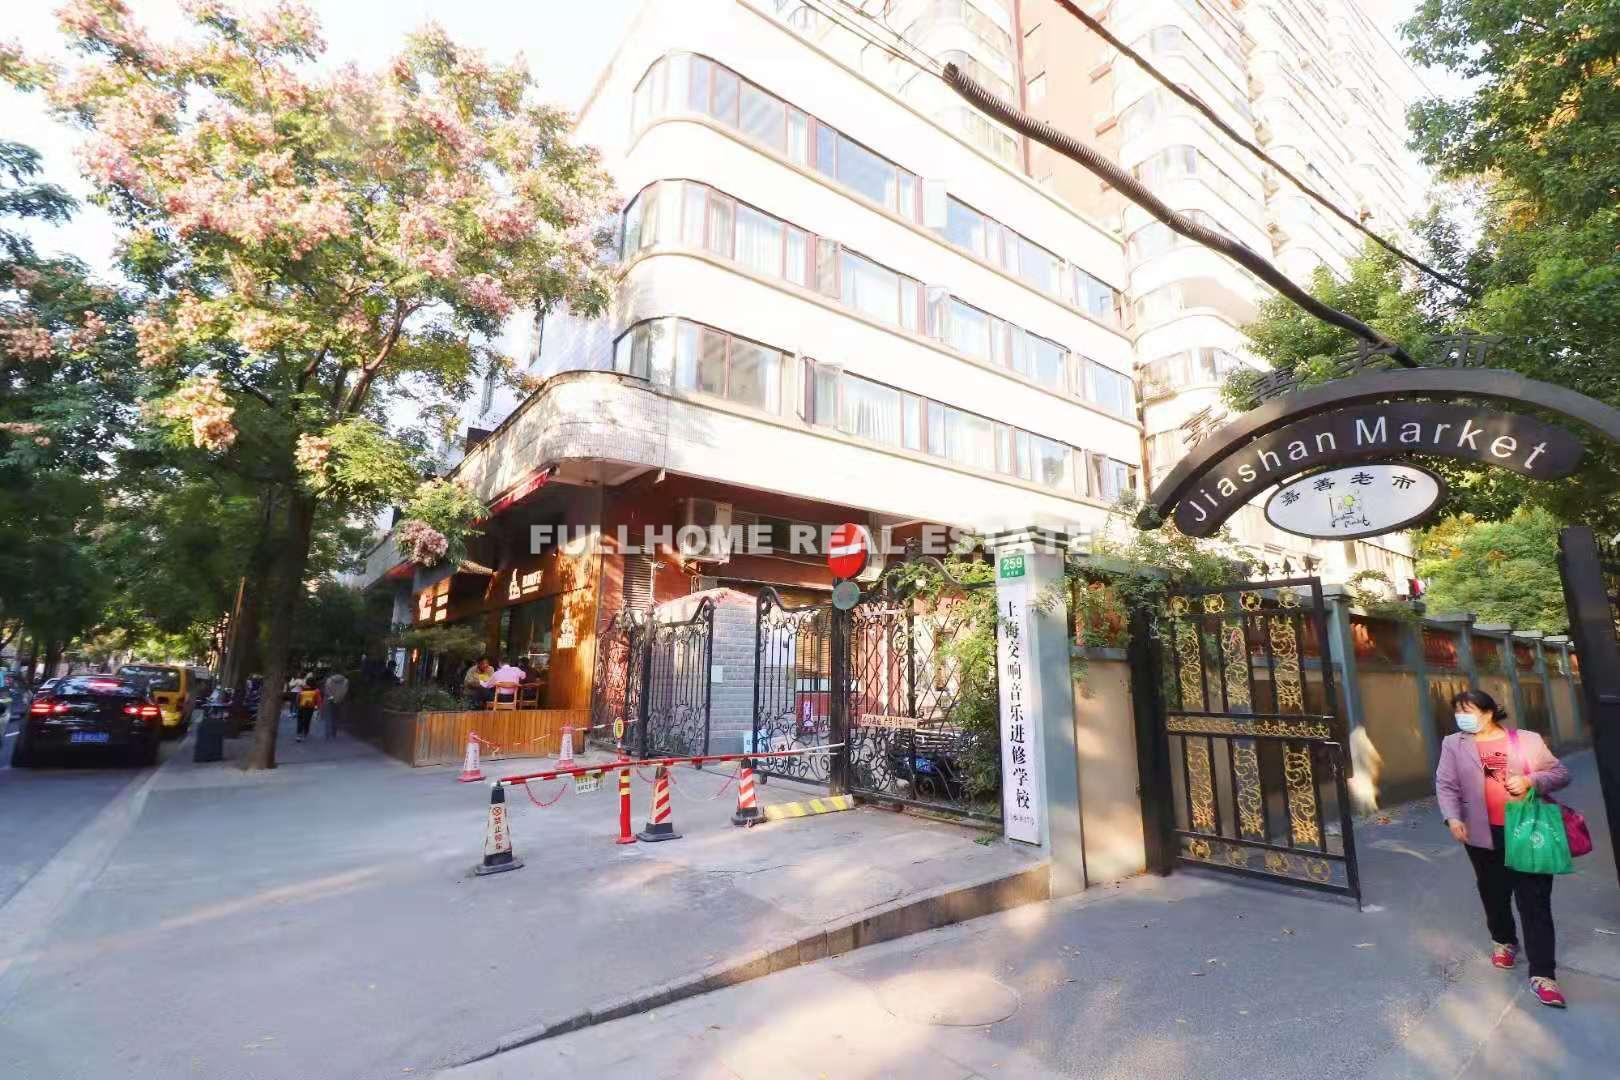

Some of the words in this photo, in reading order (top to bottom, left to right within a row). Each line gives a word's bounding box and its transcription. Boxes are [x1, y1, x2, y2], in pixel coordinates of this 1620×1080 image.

[1190, 429, 1337, 523] Jiashan
[1355, 415, 1548, 471] Market
[1280, 471, 1416, 507] 嘉善老市
[1002, 557, 1023, 570] 259
[1005, 601, 1030, 810] 上海交响音乐进修学校
